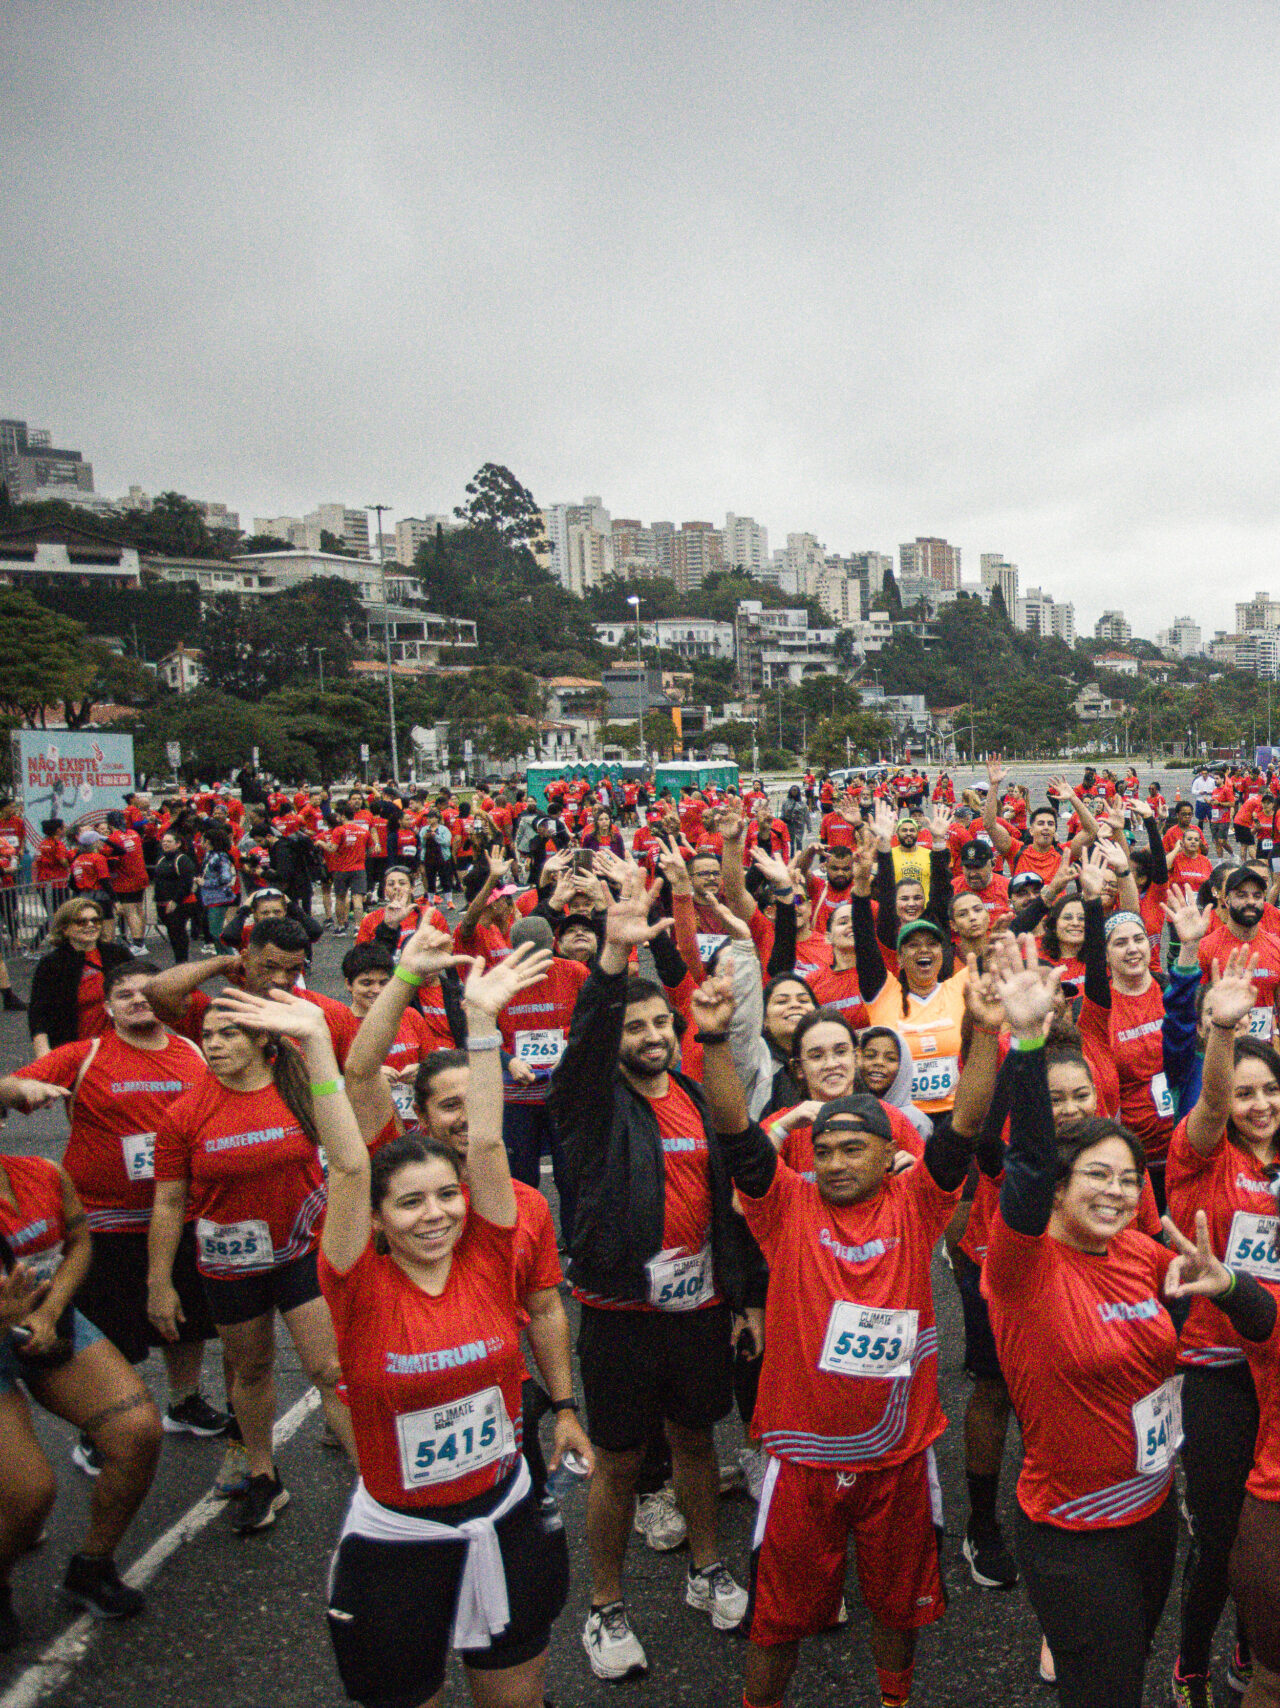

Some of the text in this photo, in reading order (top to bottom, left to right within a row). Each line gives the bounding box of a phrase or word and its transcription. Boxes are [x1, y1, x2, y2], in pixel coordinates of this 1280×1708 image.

[27, 753, 56, 772] NÃO
[58, 757, 99, 772] EXISTE
[1249, 1021, 1266, 1033] 27
[521, 1043, 559, 1056] 5263
[911, 1074, 951, 1093] 5058
[205, 1238, 257, 1257] 5825
[834, 1331, 901, 1361] 5353
[434, 1401, 475, 1425] CLIMATE
[414, 1416, 497, 1468] 5415
